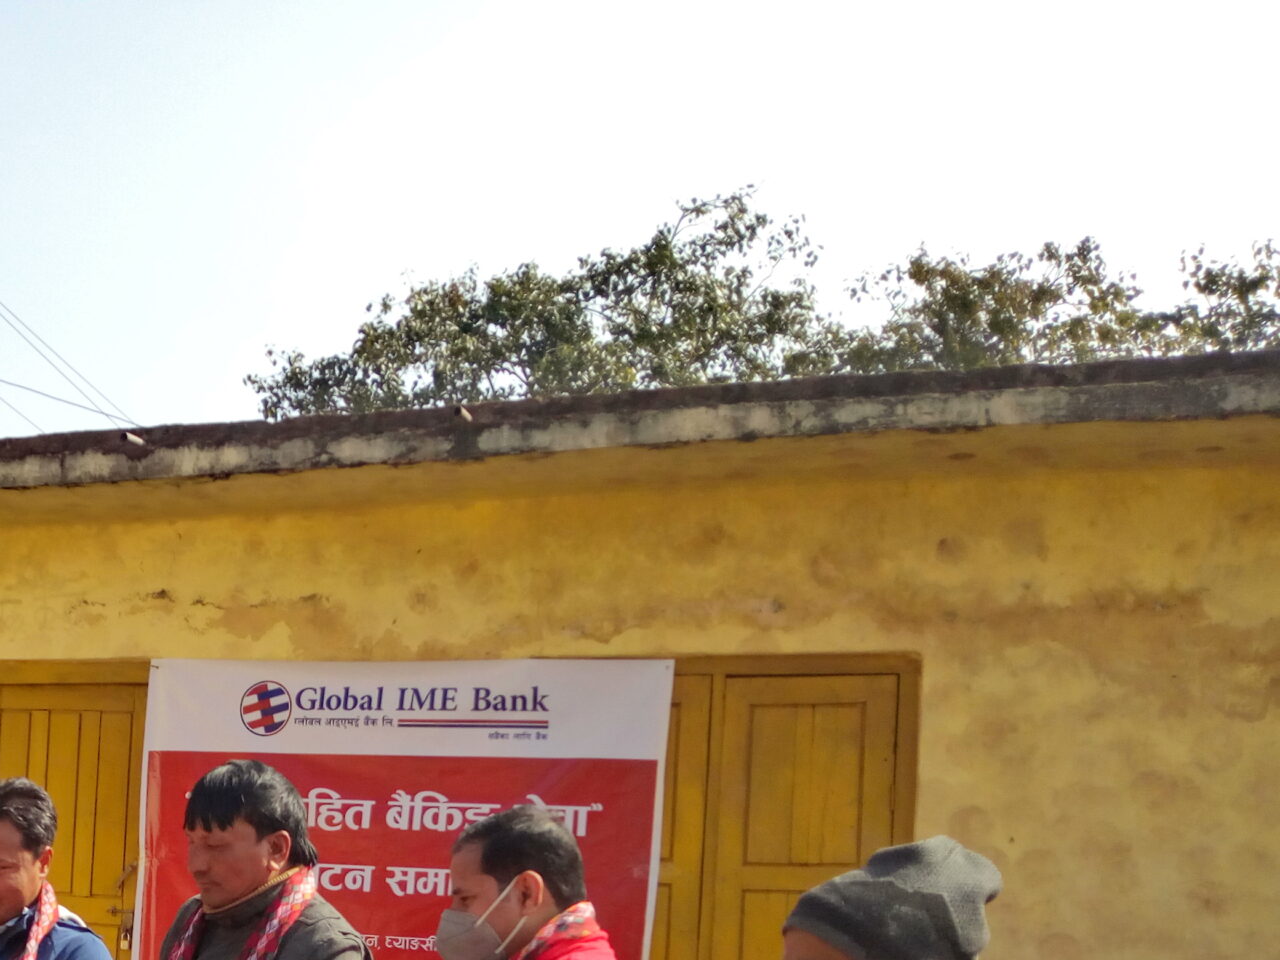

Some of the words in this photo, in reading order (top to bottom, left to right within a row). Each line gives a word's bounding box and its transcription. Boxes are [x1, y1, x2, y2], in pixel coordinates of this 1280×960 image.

[295, 686, 384, 712] Global
[395, 687, 459, 712] IME
[470, 685, 550, 713] Bank
[304, 787, 376, 832] हित
